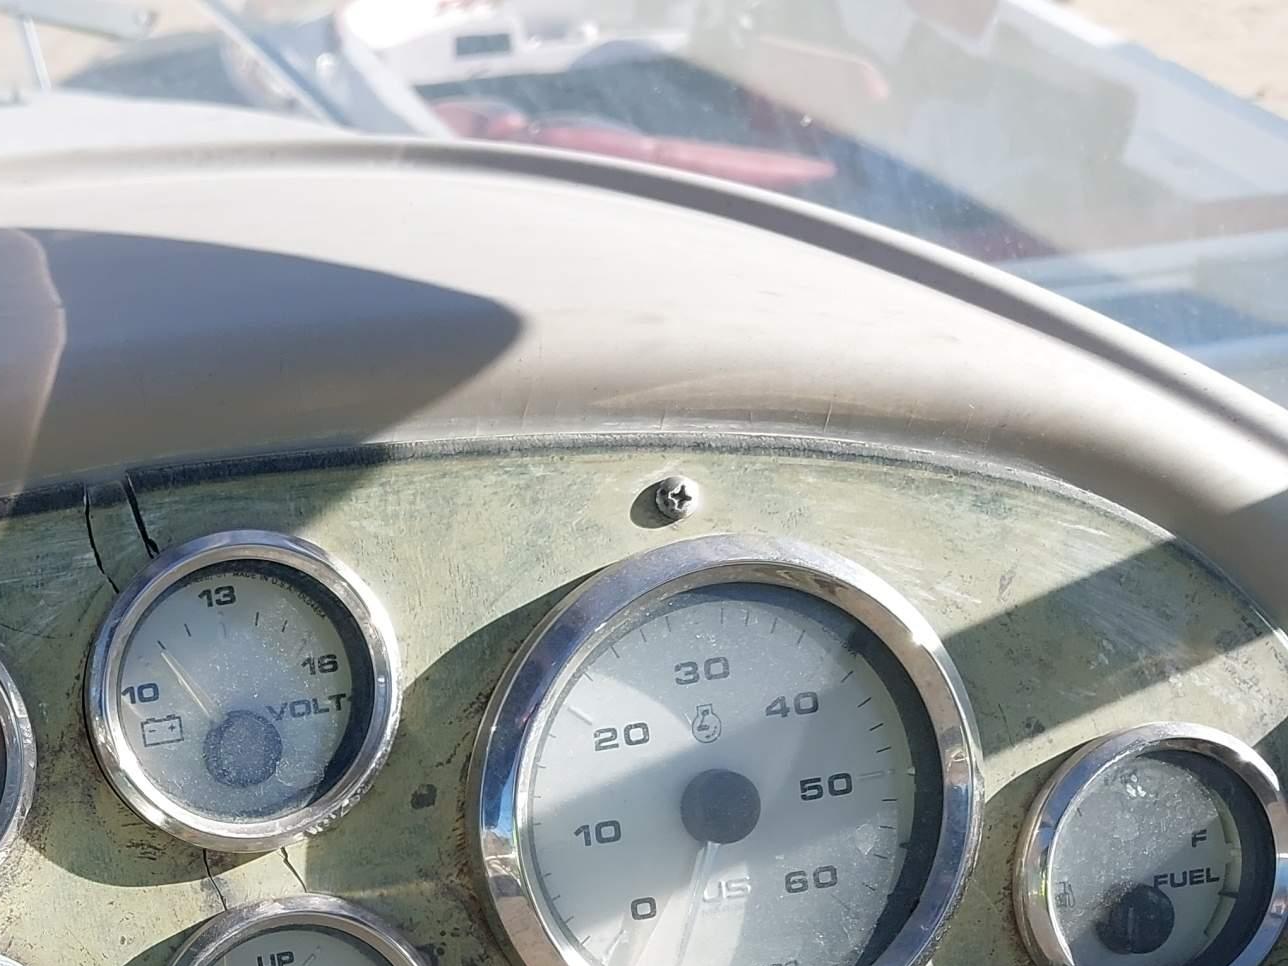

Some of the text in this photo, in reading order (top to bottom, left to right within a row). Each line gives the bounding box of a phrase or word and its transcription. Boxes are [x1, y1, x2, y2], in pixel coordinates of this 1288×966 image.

[198, 585, 237, 608] 13
[300, 654, 339, 676] 16
[673, 656, 731, 685] 30
[121, 682, 160, 705] 10
[266, 692, 347, 722] VOLT
[765, 692, 819, 719] 40
[593, 722, 650, 752] 20
[799, 772, 854, 801] 50
[573, 819, 622, 847] 10
[1191, 829, 1208, 848] F
[784, 865, 839, 894] 60
[1153, 867, 1220, 889] FUEL
[630, 896, 657, 921] 0
